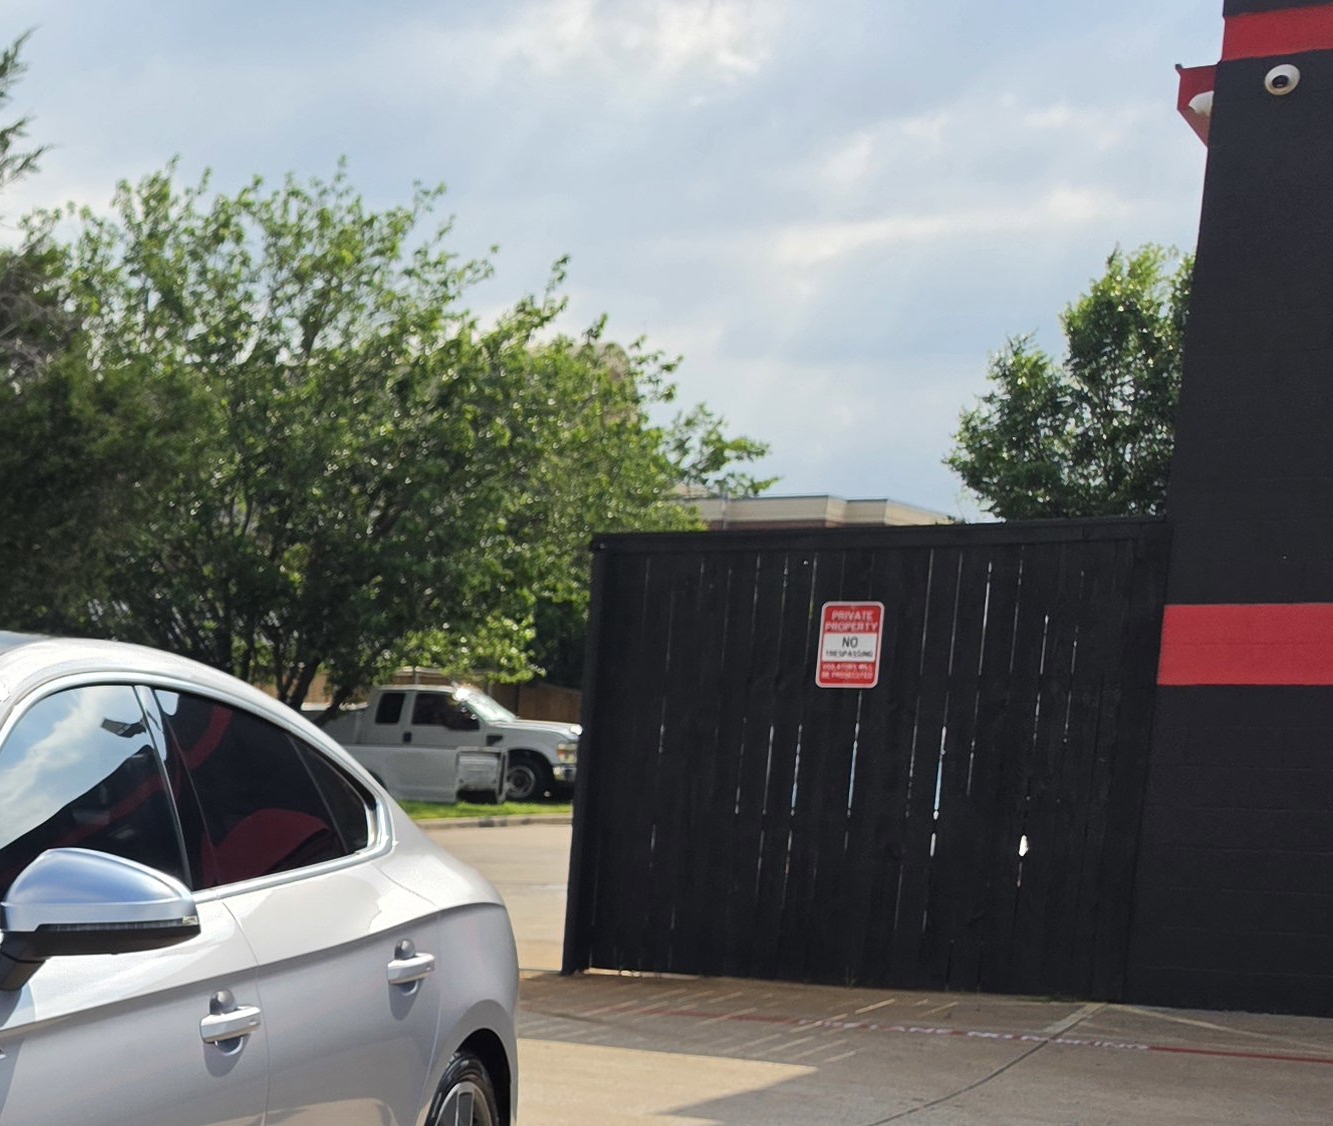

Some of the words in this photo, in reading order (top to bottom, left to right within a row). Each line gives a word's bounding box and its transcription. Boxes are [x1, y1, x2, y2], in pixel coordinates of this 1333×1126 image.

[831, 609, 874, 621] PRIVATE
[824, 621, 878, 632] PROPERTY
[842, 636, 858, 649] NO
